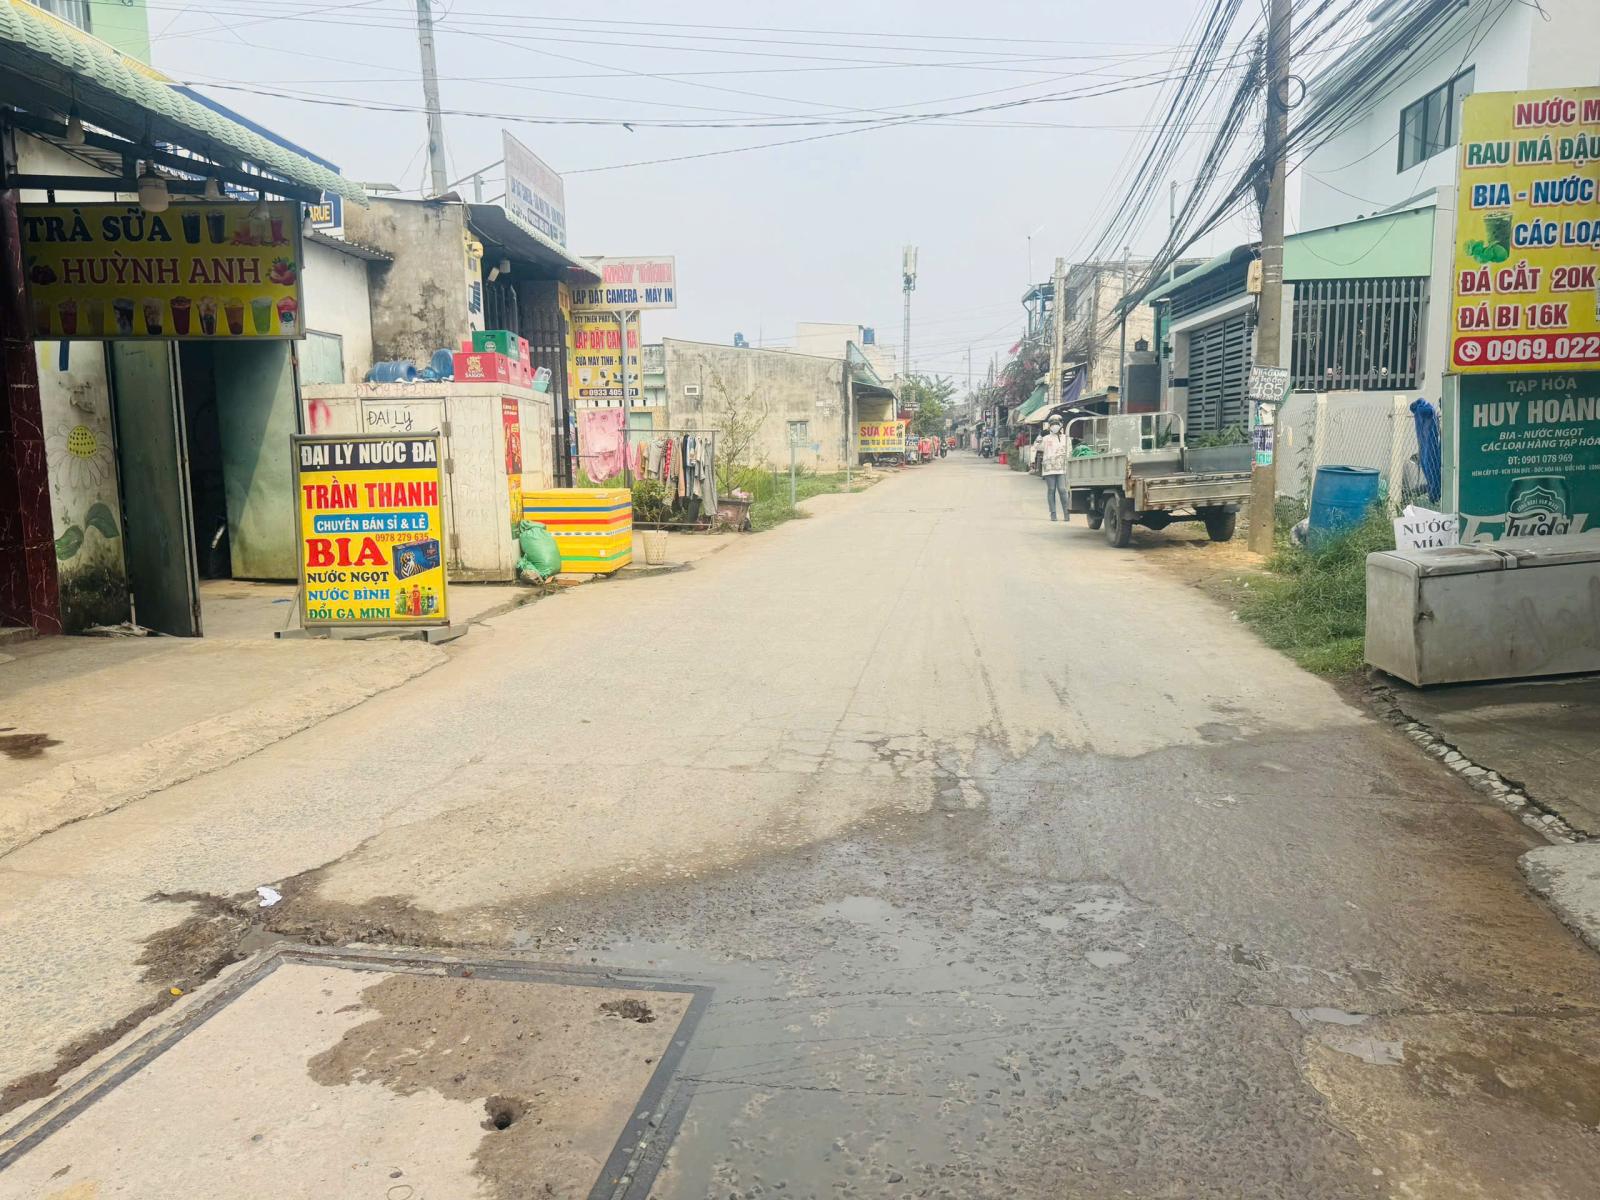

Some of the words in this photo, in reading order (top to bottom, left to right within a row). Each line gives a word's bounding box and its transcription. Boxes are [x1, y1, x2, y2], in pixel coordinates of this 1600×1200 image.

[1516, 97, 1576, 126] NƯỚC
[1467, 142, 1510, 165] RAU
[1517, 134, 1552, 163] MÁ
[1473, 183, 1511, 207] BIA
[1533, 175, 1594, 204] NƯỚC
[23, 208, 94, 242] TRÀ
[102, 207, 172, 242] SỮA
[1514, 219, 1557, 246] CÁC
[62, 250, 180, 284] HUỲNH
[188, 257, 262, 284] ANH
[1460, 266, 1491, 292] ĐÁ
[1499, 261, 1541, 291] CẮT
[1553, 266, 1596, 289] 20K
[606, 288, 638, 304] CAMERA
[645, 286, 662, 303] MÁY
[665, 287, 673, 302] IN
[1459, 302, 1490, 328] ĐÁ
[1498, 305, 1519, 327] BI
[1527, 304, 1568, 326] 16K
[1507, 380, 1538, 396] TẠP
[1541, 376, 1577, 391] HÓA
[1473, 401, 1520, 428] HUY
[883, 426, 895, 437] XE
[1499, 431, 1516, 440] BIA
[1523, 428, 1554, 439] NƯỚC
[1555, 428, 1584, 440] NGỌT
[301, 444, 330, 469] ĐẠI
[335, 441, 354, 465] LÝ
[359, 440, 407, 464] NƯỚC
[412, 439, 437, 462] ĐÁ
[1481, 441, 1501, 452] CÁC
[1502, 441, 1525, 452] LOẠI
[1527, 438, 1557, 449] HÀNG
[1559, 439, 1578, 450] TẠP
[1521, 455, 1540, 464] 0901
[1542, 454, 1557, 463] 078
[1558, 453, 1573, 462] 969
[303, 475, 358, 510] TRẦN
[364, 481, 438, 508] THANH
[317, 517, 359, 531] CHUYÊN
[362, 516, 384, 530] BÁN
[387, 514, 398, 530] SỈ
[401, 518, 409, 529] &
[412, 514, 426, 529] LẺ
[1403, 518, 1454, 536] NƯỚC
[375, 533, 395, 542] 0978
[397, 533, 412, 542] 279
[414, 532, 429, 541] 635
[1413, 535, 1444, 549] MÍA
[305, 536, 389, 567] BIA
[307, 569, 347, 584] NƯỚC
[350, 571, 390, 585] NGỌT
[308, 587, 350, 601] NƯỚC
[353, 586, 390, 600] BÌNH
[309, 603, 332, 619] ĐỔI
[337, 608, 356, 619] GA
[360, 607, 391, 619] MINI
